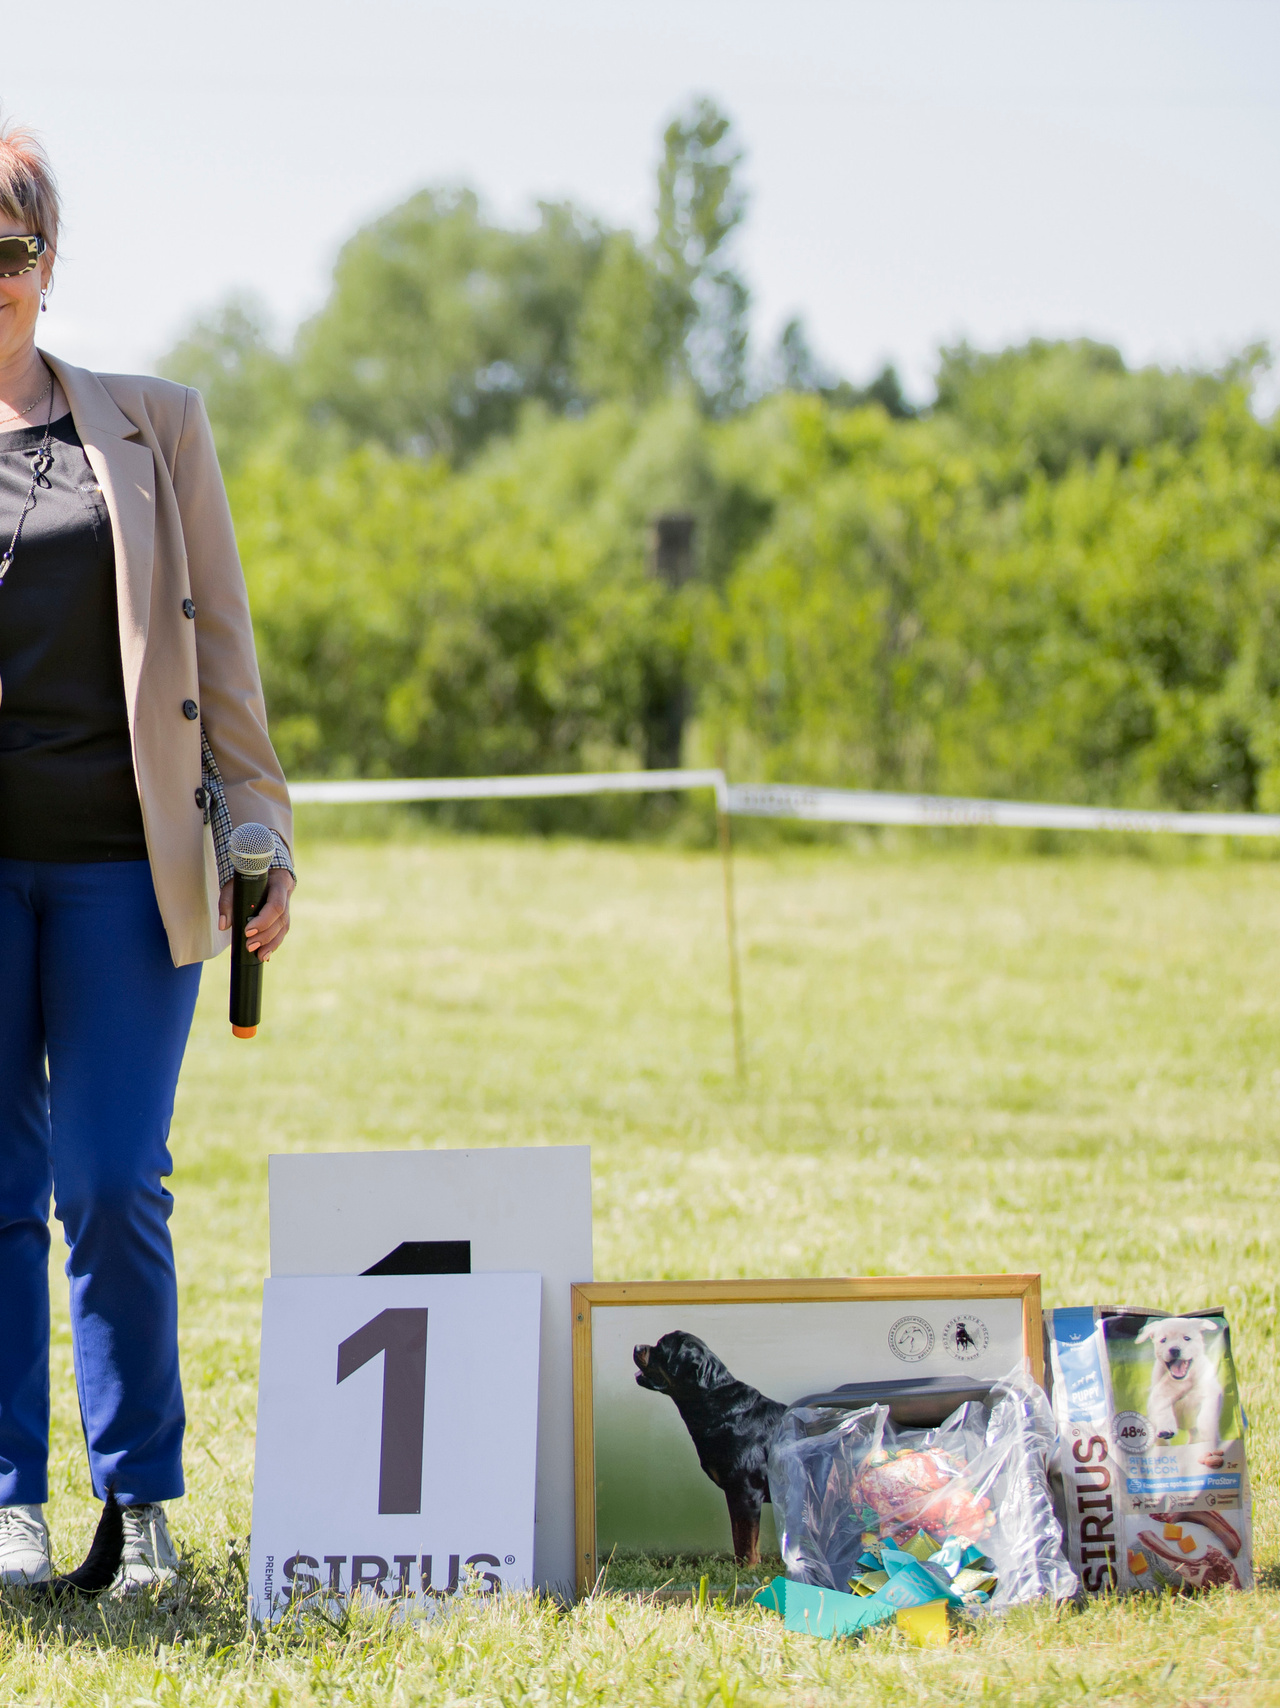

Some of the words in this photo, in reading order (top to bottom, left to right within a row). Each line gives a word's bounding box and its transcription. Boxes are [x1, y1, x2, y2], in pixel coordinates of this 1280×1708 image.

[336, 1307, 429, 1515] 1
[1071, 1385, 1099, 1404] PUPPY
[1120, 1425, 1147, 1439] 48%
[1140, 1466, 1179, 1475] РИСОМ
[1072, 1435, 1118, 1592] SIRIUS
[264, 1555, 275, 1600] PREMIUM
[281, 1553, 502, 1600] SIRIUS
